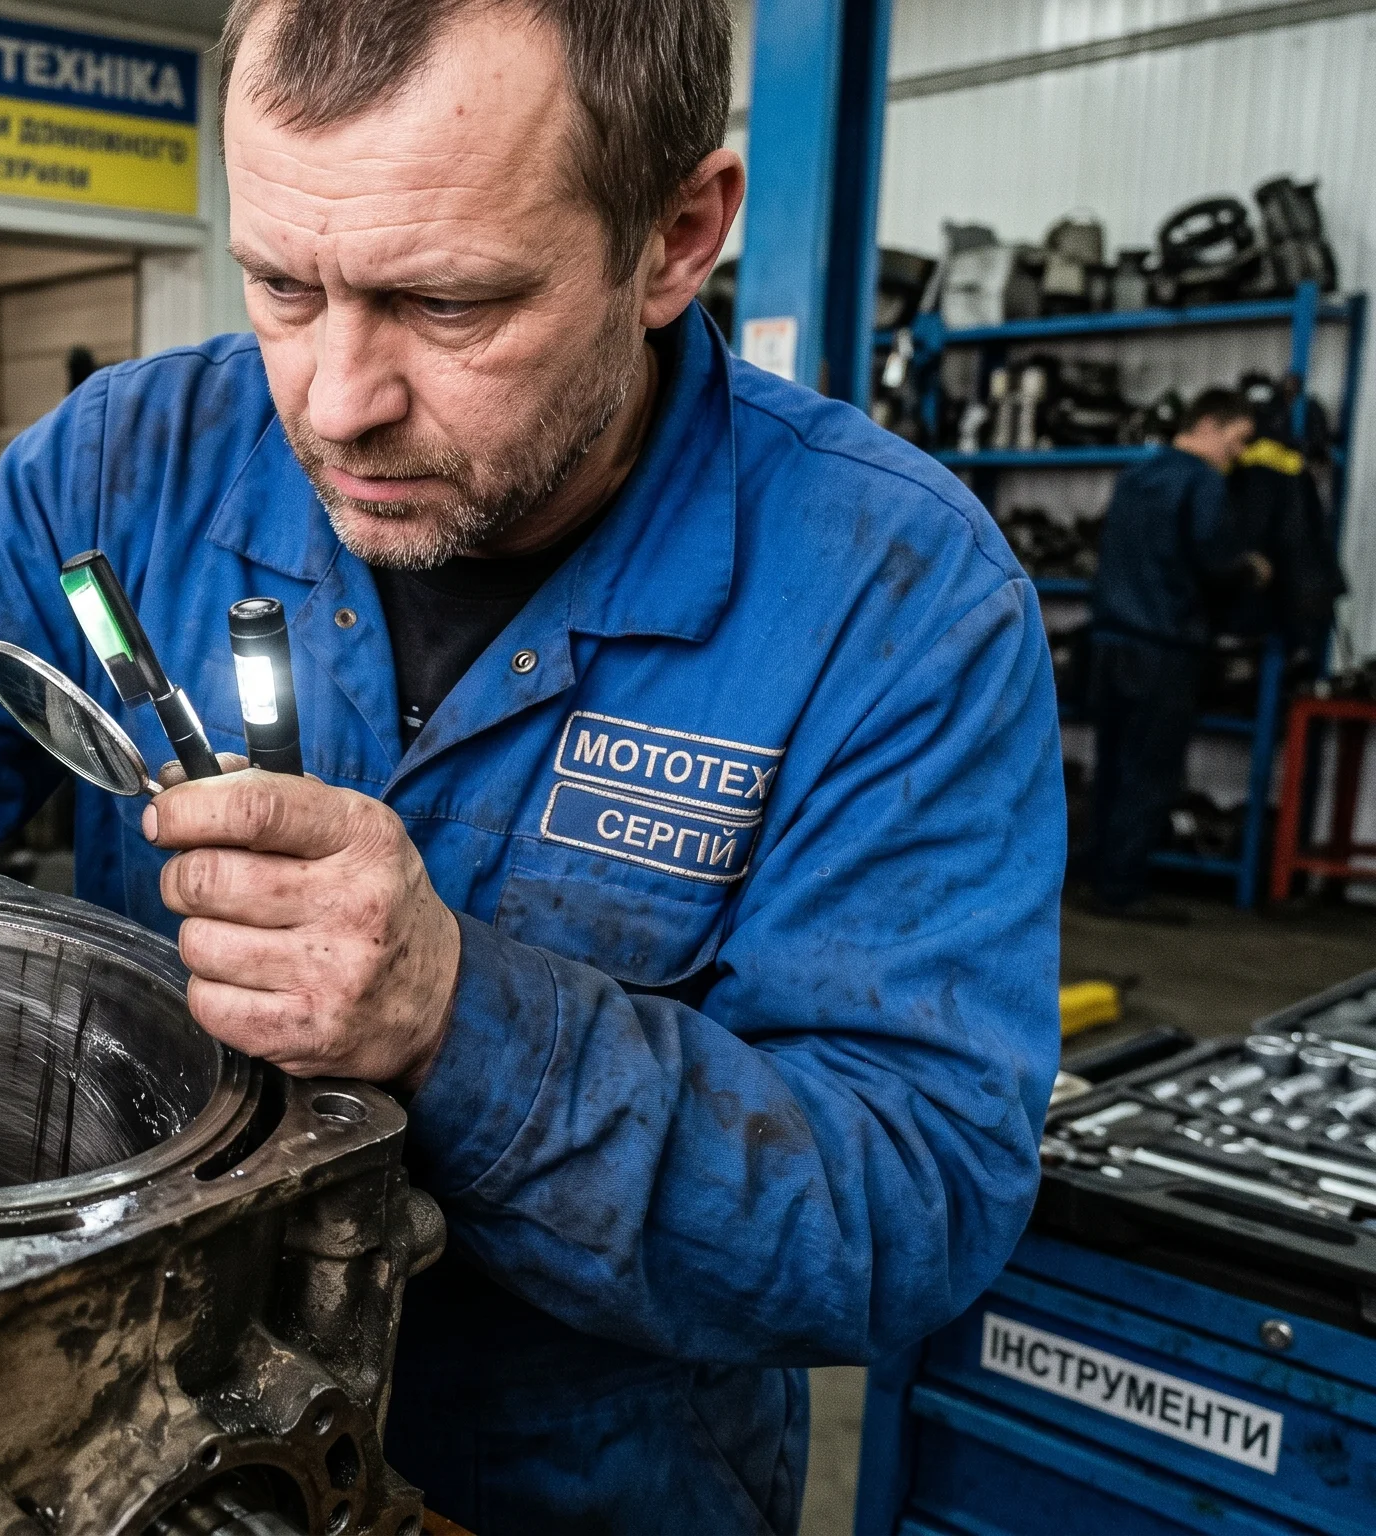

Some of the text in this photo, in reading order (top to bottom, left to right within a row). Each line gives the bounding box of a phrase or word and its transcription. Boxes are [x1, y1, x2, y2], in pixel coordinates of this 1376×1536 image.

[574, 730, 777, 799] МОТОТЕХ
[597, 809, 737, 868] СЕРГІЙ
[990, 1327, 1271, 1458] ІНСТРУМЕНТИ
